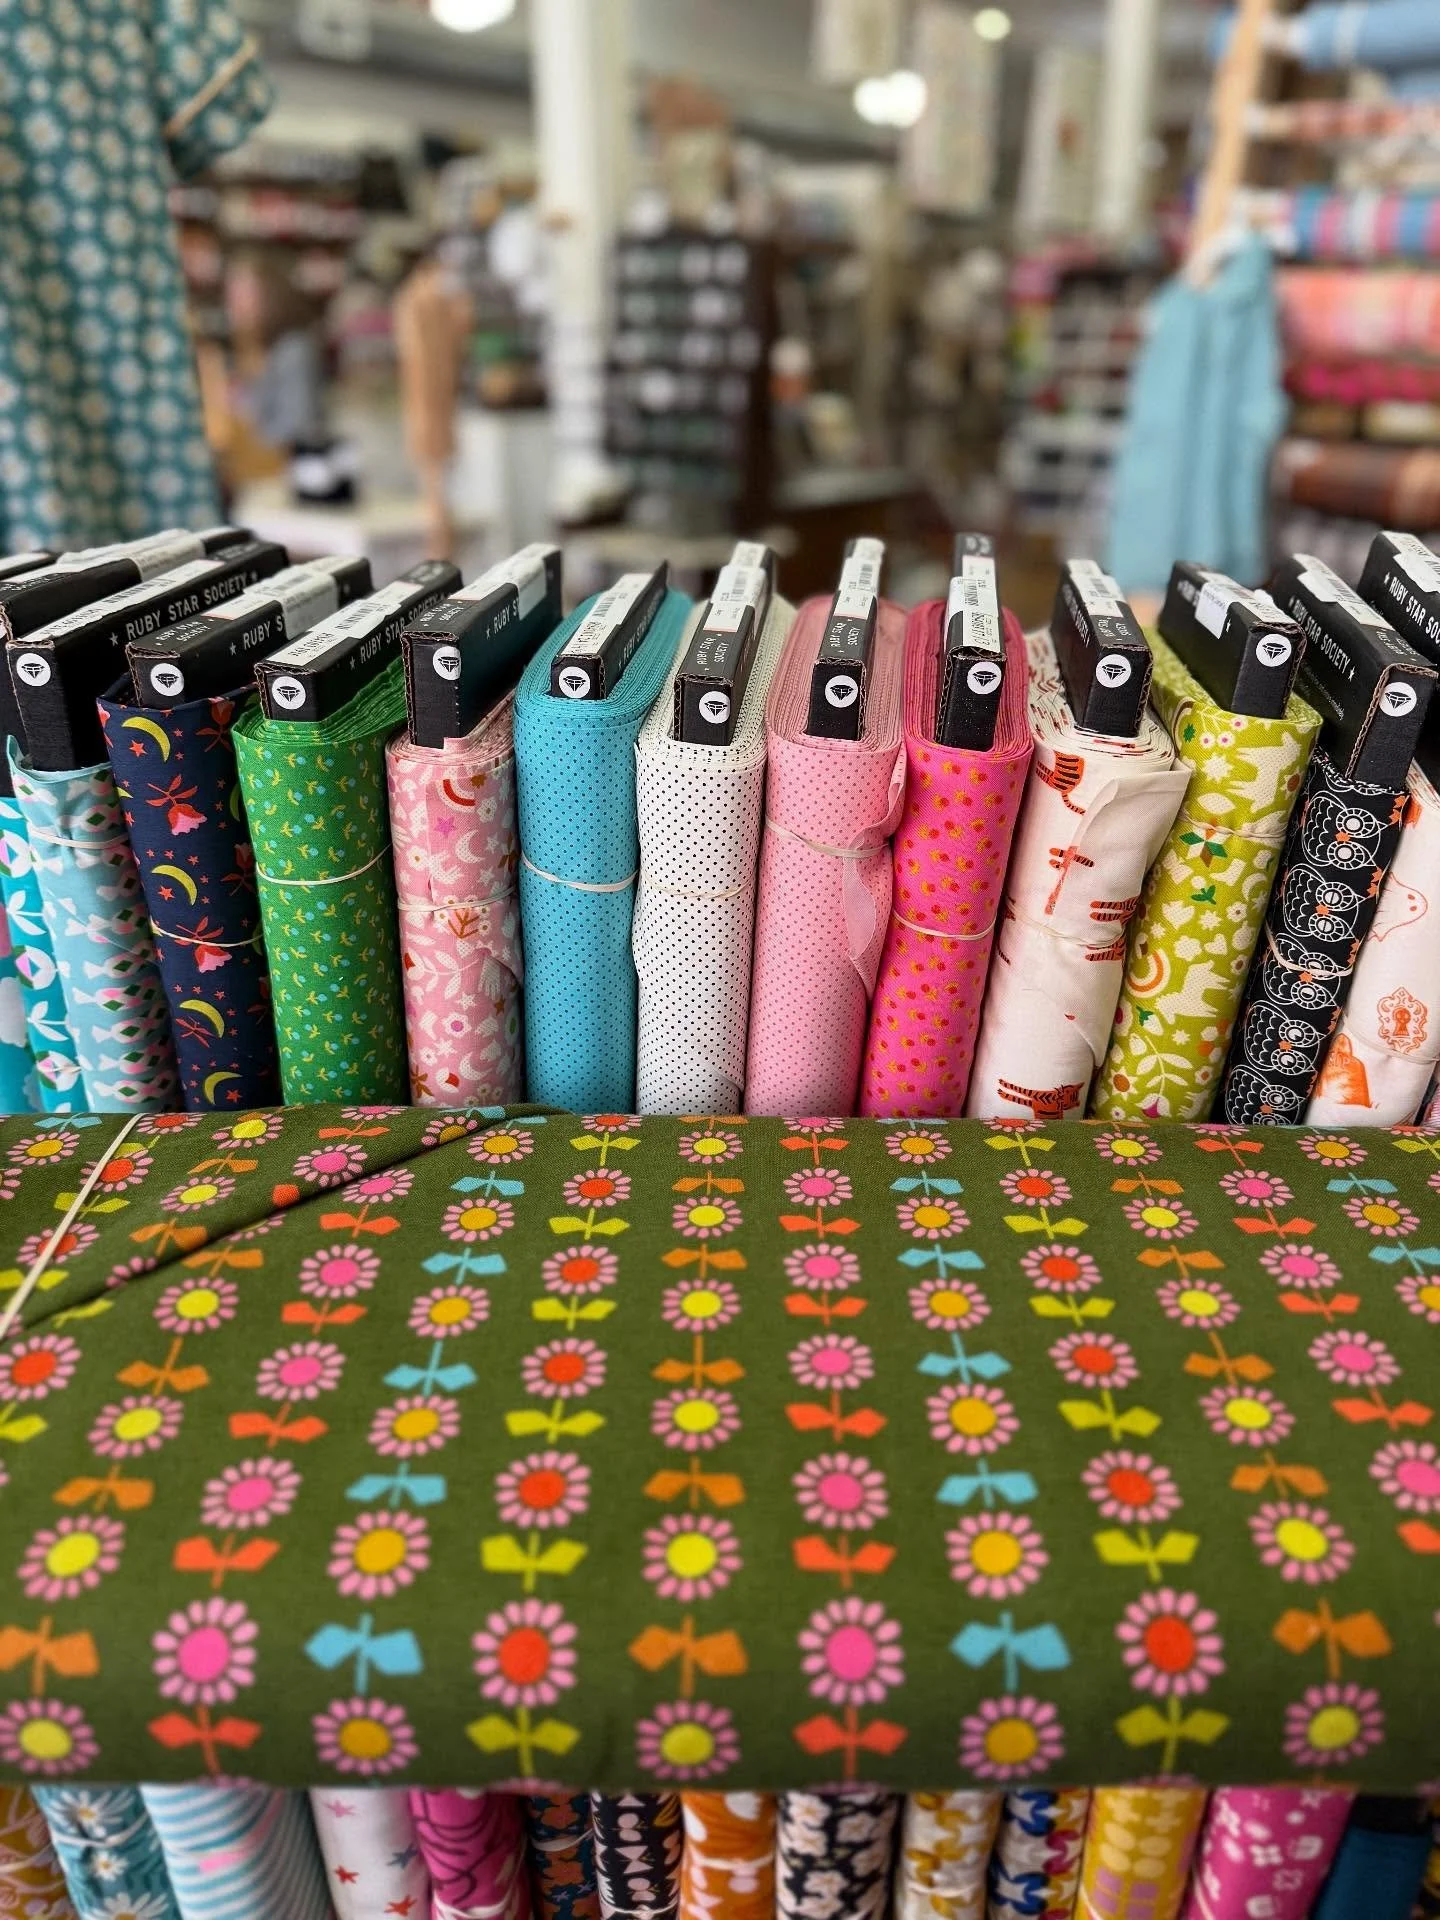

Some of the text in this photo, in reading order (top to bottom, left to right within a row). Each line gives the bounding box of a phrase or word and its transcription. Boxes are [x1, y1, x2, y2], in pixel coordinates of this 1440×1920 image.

[126, 610, 161, 640] RUBY
[168, 595, 199, 622] STAR
[204, 573, 248, 605] SOCIETY
[493, 607, 511, 635] RUBY
[1389, 576, 1408, 605] RUBY
[1406, 596, 1426, 627] STAR
[243, 622, 271, 650] RUBY
[276, 615, 285, 632] S
[360, 634, 382, 664] RUBY
[384, 618, 406, 645] STAR
[1304, 616, 1322, 645] STAR
[1320, 634, 1351, 675] SOCIETY
